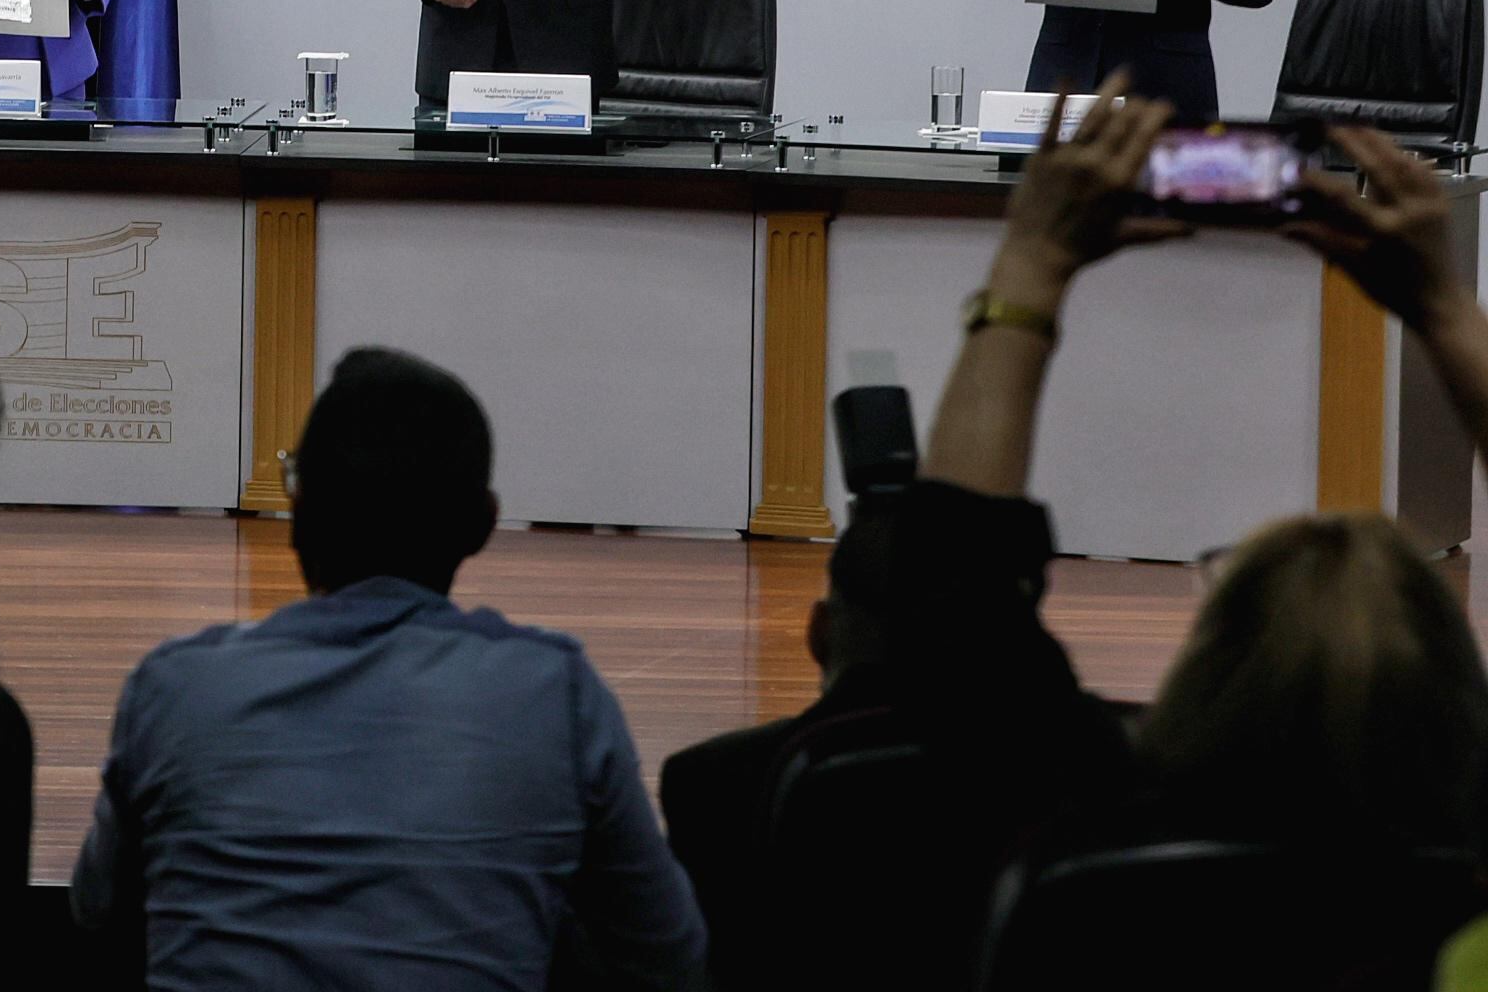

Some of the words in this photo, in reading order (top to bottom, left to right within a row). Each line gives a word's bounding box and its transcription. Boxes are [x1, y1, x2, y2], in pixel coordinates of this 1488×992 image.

[13, 392, 42, 412] de
[49, 393, 172, 415] Elecciones
[7, 421, 162, 439] EMOCRACIA
